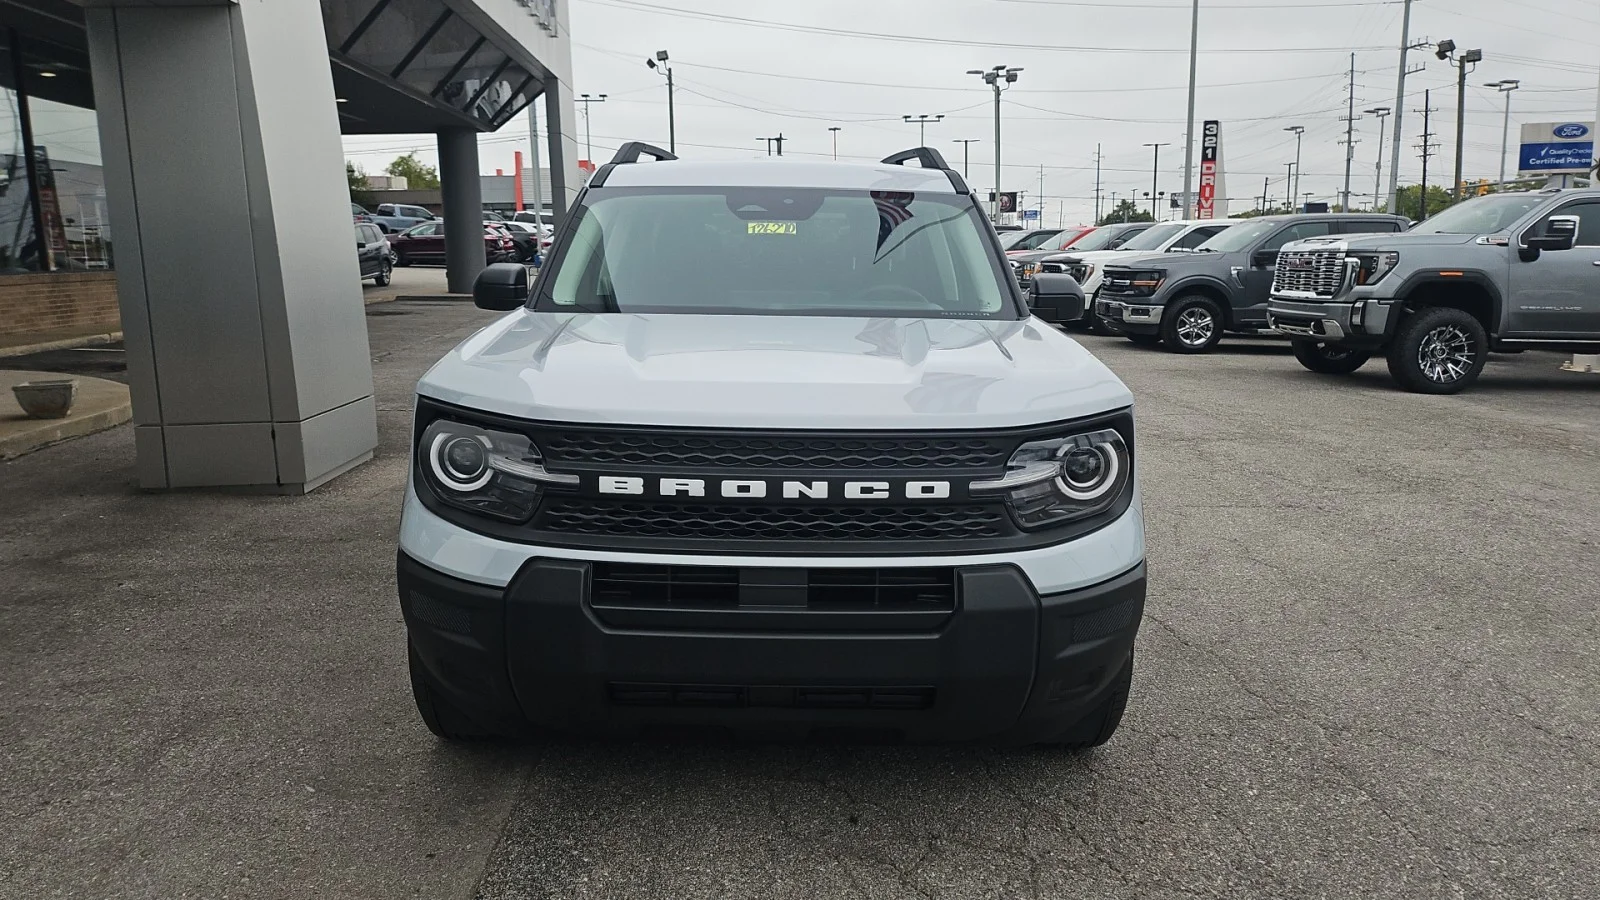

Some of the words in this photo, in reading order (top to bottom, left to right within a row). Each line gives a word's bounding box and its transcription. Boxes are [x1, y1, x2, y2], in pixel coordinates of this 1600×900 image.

[1204, 124, 1218, 159] 321
[1529, 157, 1565, 165] Certified
[1200, 163, 1216, 218] DRIVE
[598, 476, 950, 499] BRONCO
